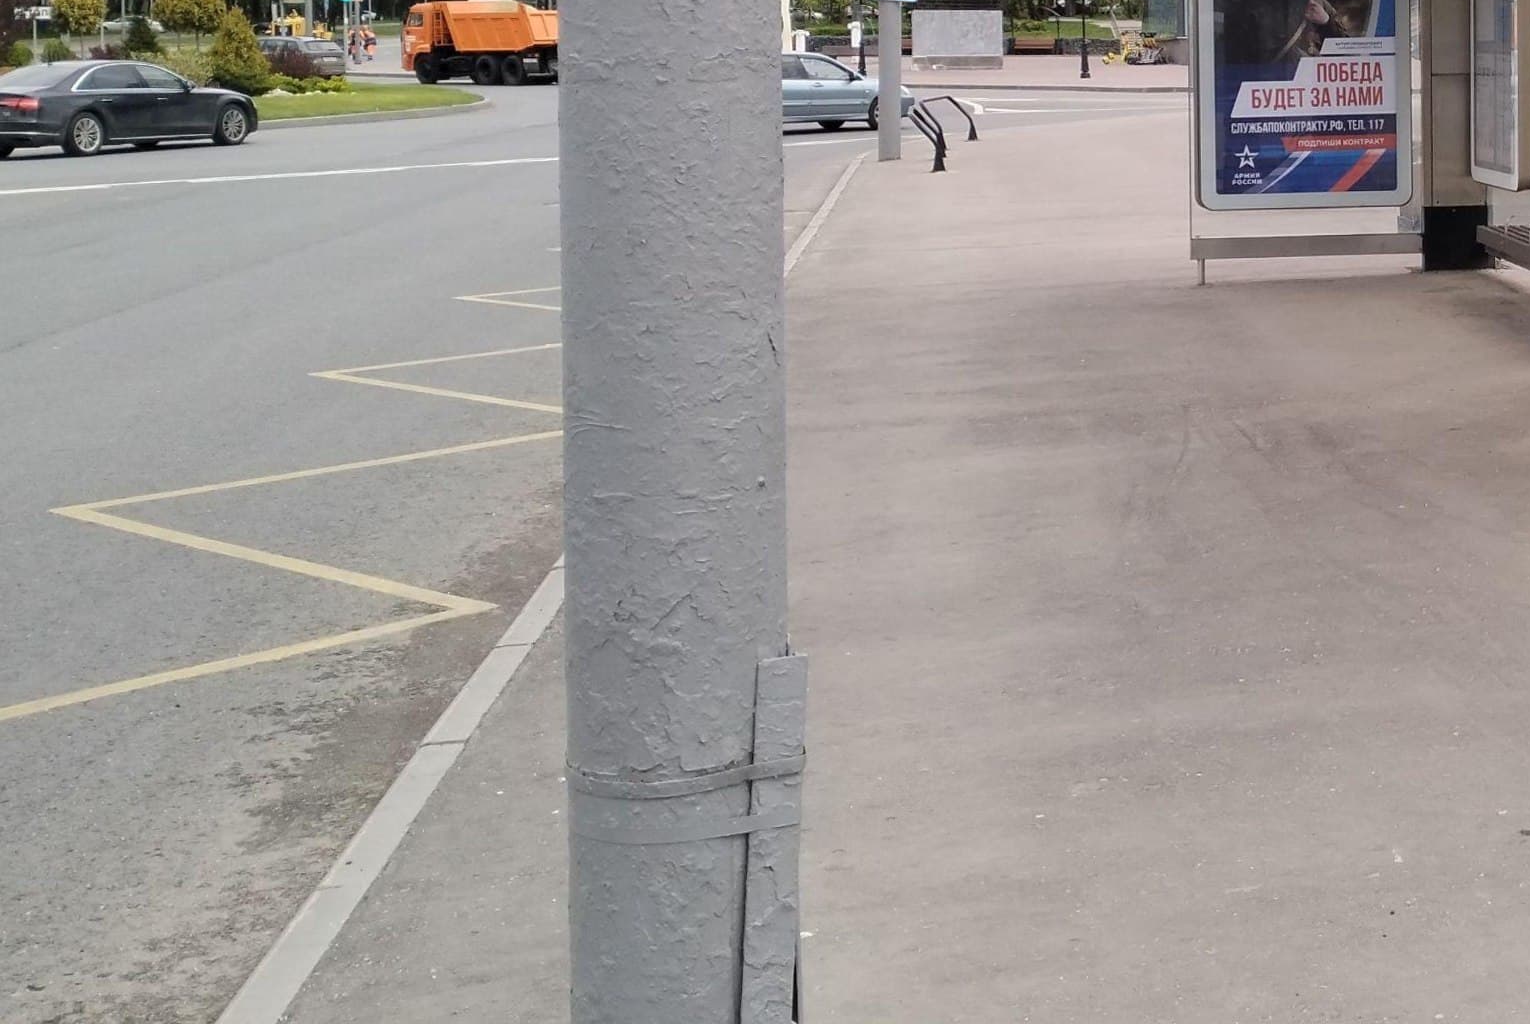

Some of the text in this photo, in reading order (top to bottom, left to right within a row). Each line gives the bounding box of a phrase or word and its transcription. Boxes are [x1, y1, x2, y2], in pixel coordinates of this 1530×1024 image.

[1316, 62, 1384, 84] ПОБЕДА
[1251, 86, 1384, 111] БУДЕТ ЗА НАМИ
[1348, 119, 1366, 132] ТЕЛ.
[1369, 118, 1385, 131] 117
[1298, 138, 1385, 148] ПОДПИШИ КОНТРАКТ
